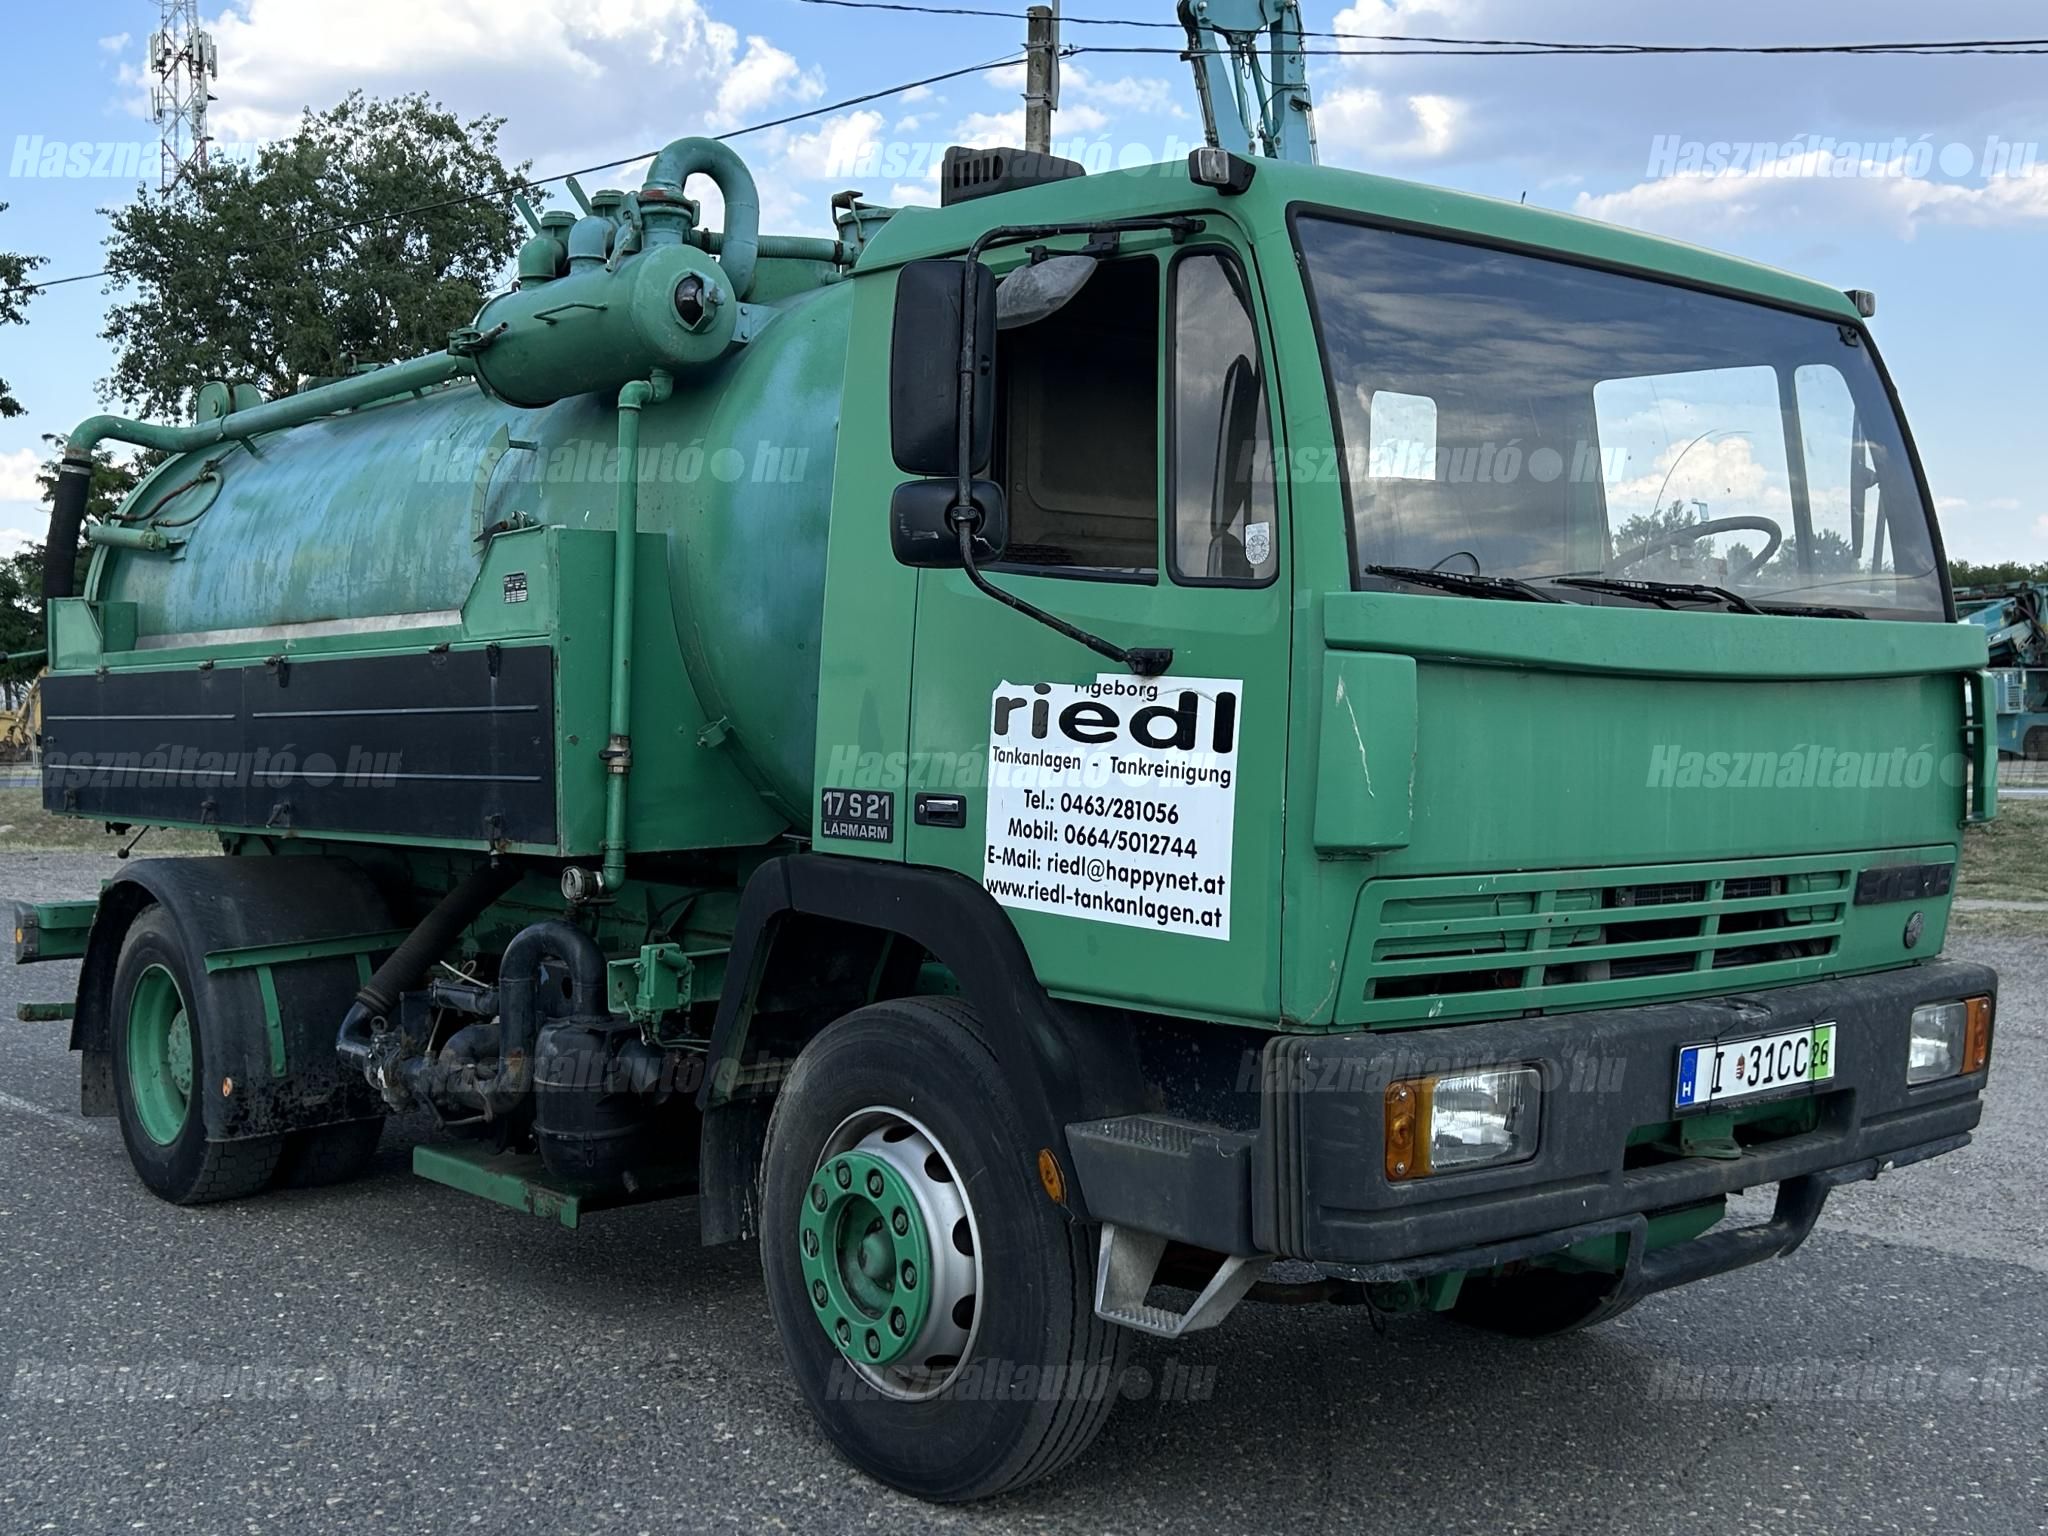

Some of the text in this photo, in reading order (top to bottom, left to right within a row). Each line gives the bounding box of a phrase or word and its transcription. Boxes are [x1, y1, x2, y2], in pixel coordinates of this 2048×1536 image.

[993, 683, 1237, 754] riedl
[993, 746, 1082, 772] Tankanlagen
[1110, 756, 1232, 789] Tankreinigung
[823, 791, 891, 821] 17 S 21
[1024, 789, 1180, 825] Tel.: 0463/281056
[823, 820, 888, 840] LÄRMARM
[1008, 817, 1199, 859] Mobil: 0664/5012744
[987, 844, 1227, 897] E-Mail: riedl@happynet.at
[986, 876, 1224, 929] www.riedl-tankanlagen.at
[1747, 1036, 1809, 1087] 31CC
[1811, 1039, 1829, 1068] 26
[1681, 1081, 1692, 1098] H
